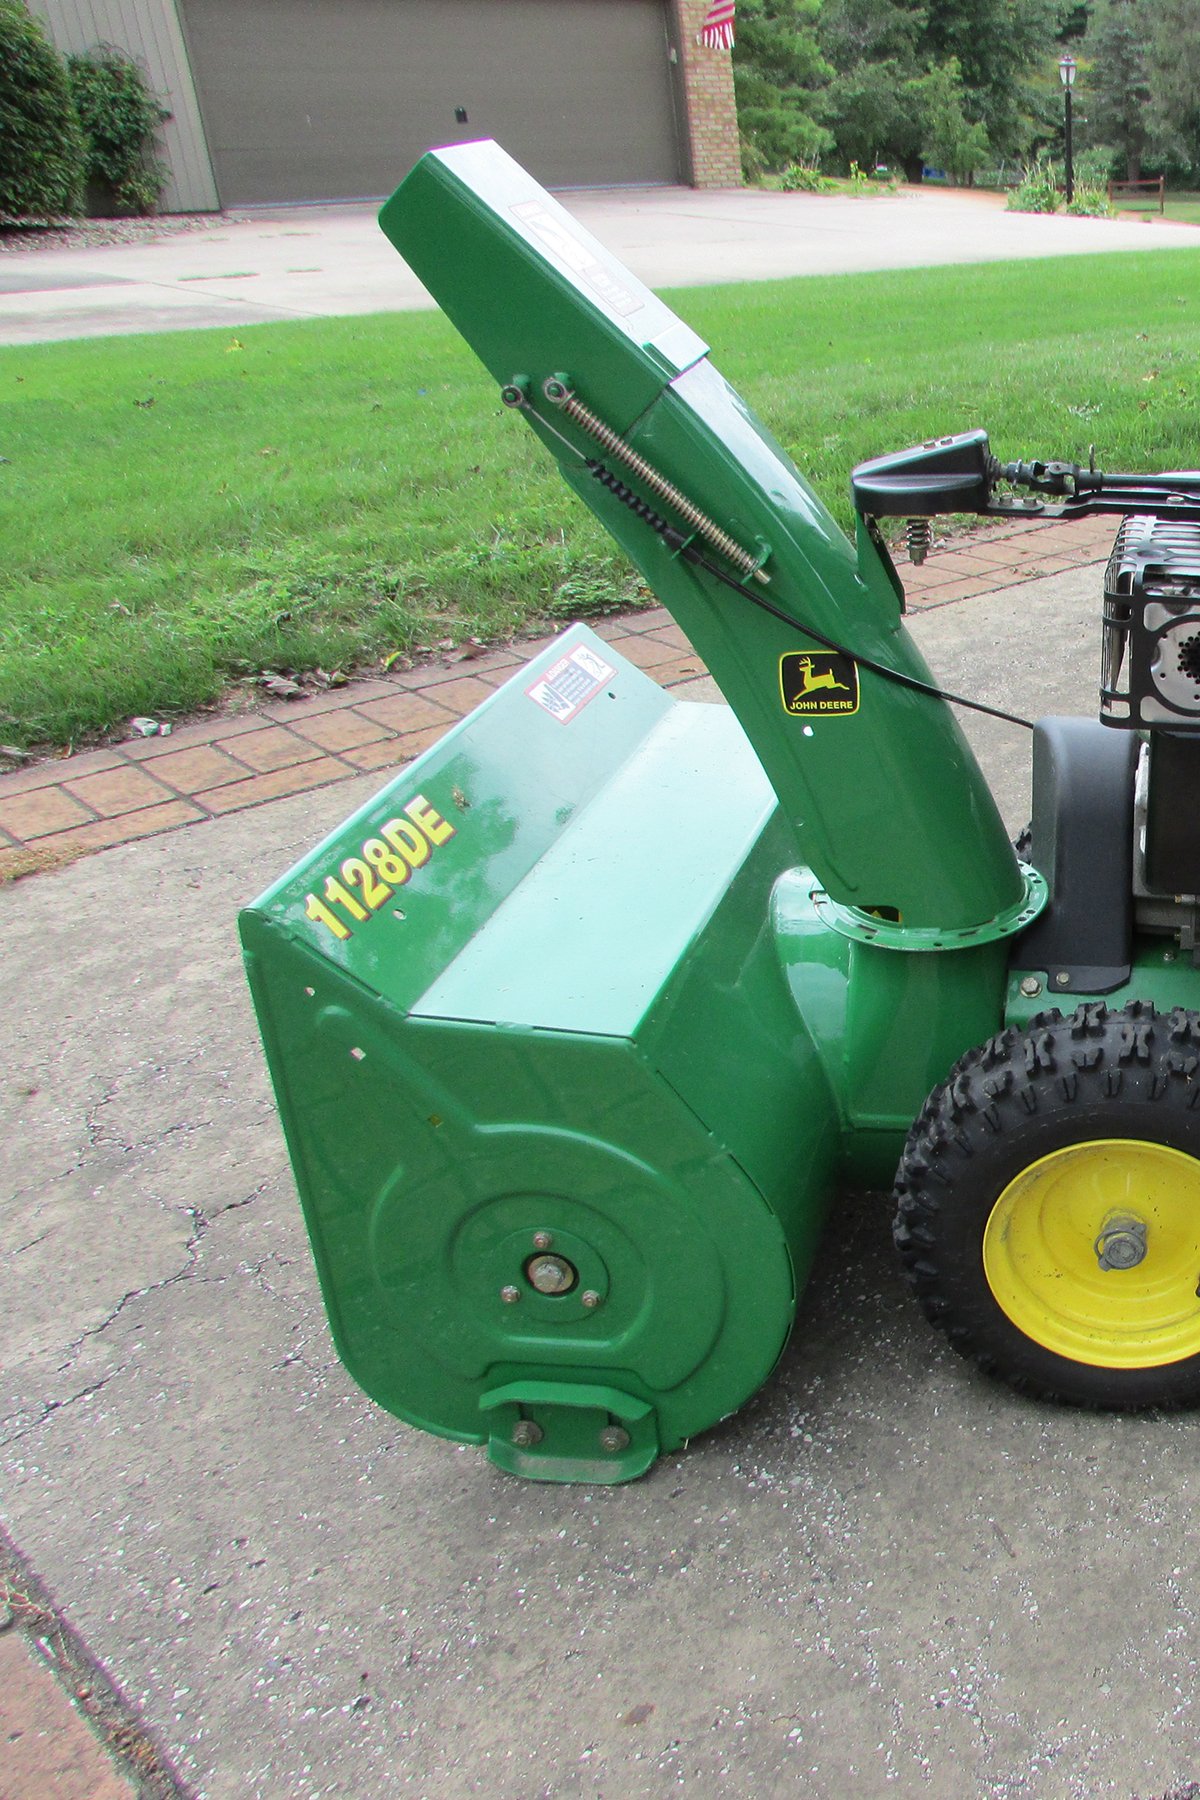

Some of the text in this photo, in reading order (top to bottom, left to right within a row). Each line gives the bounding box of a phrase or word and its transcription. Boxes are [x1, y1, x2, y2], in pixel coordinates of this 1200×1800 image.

[790, 701, 853, 710] JOHN DEERE
[304, 794, 458, 940] 1128DE
